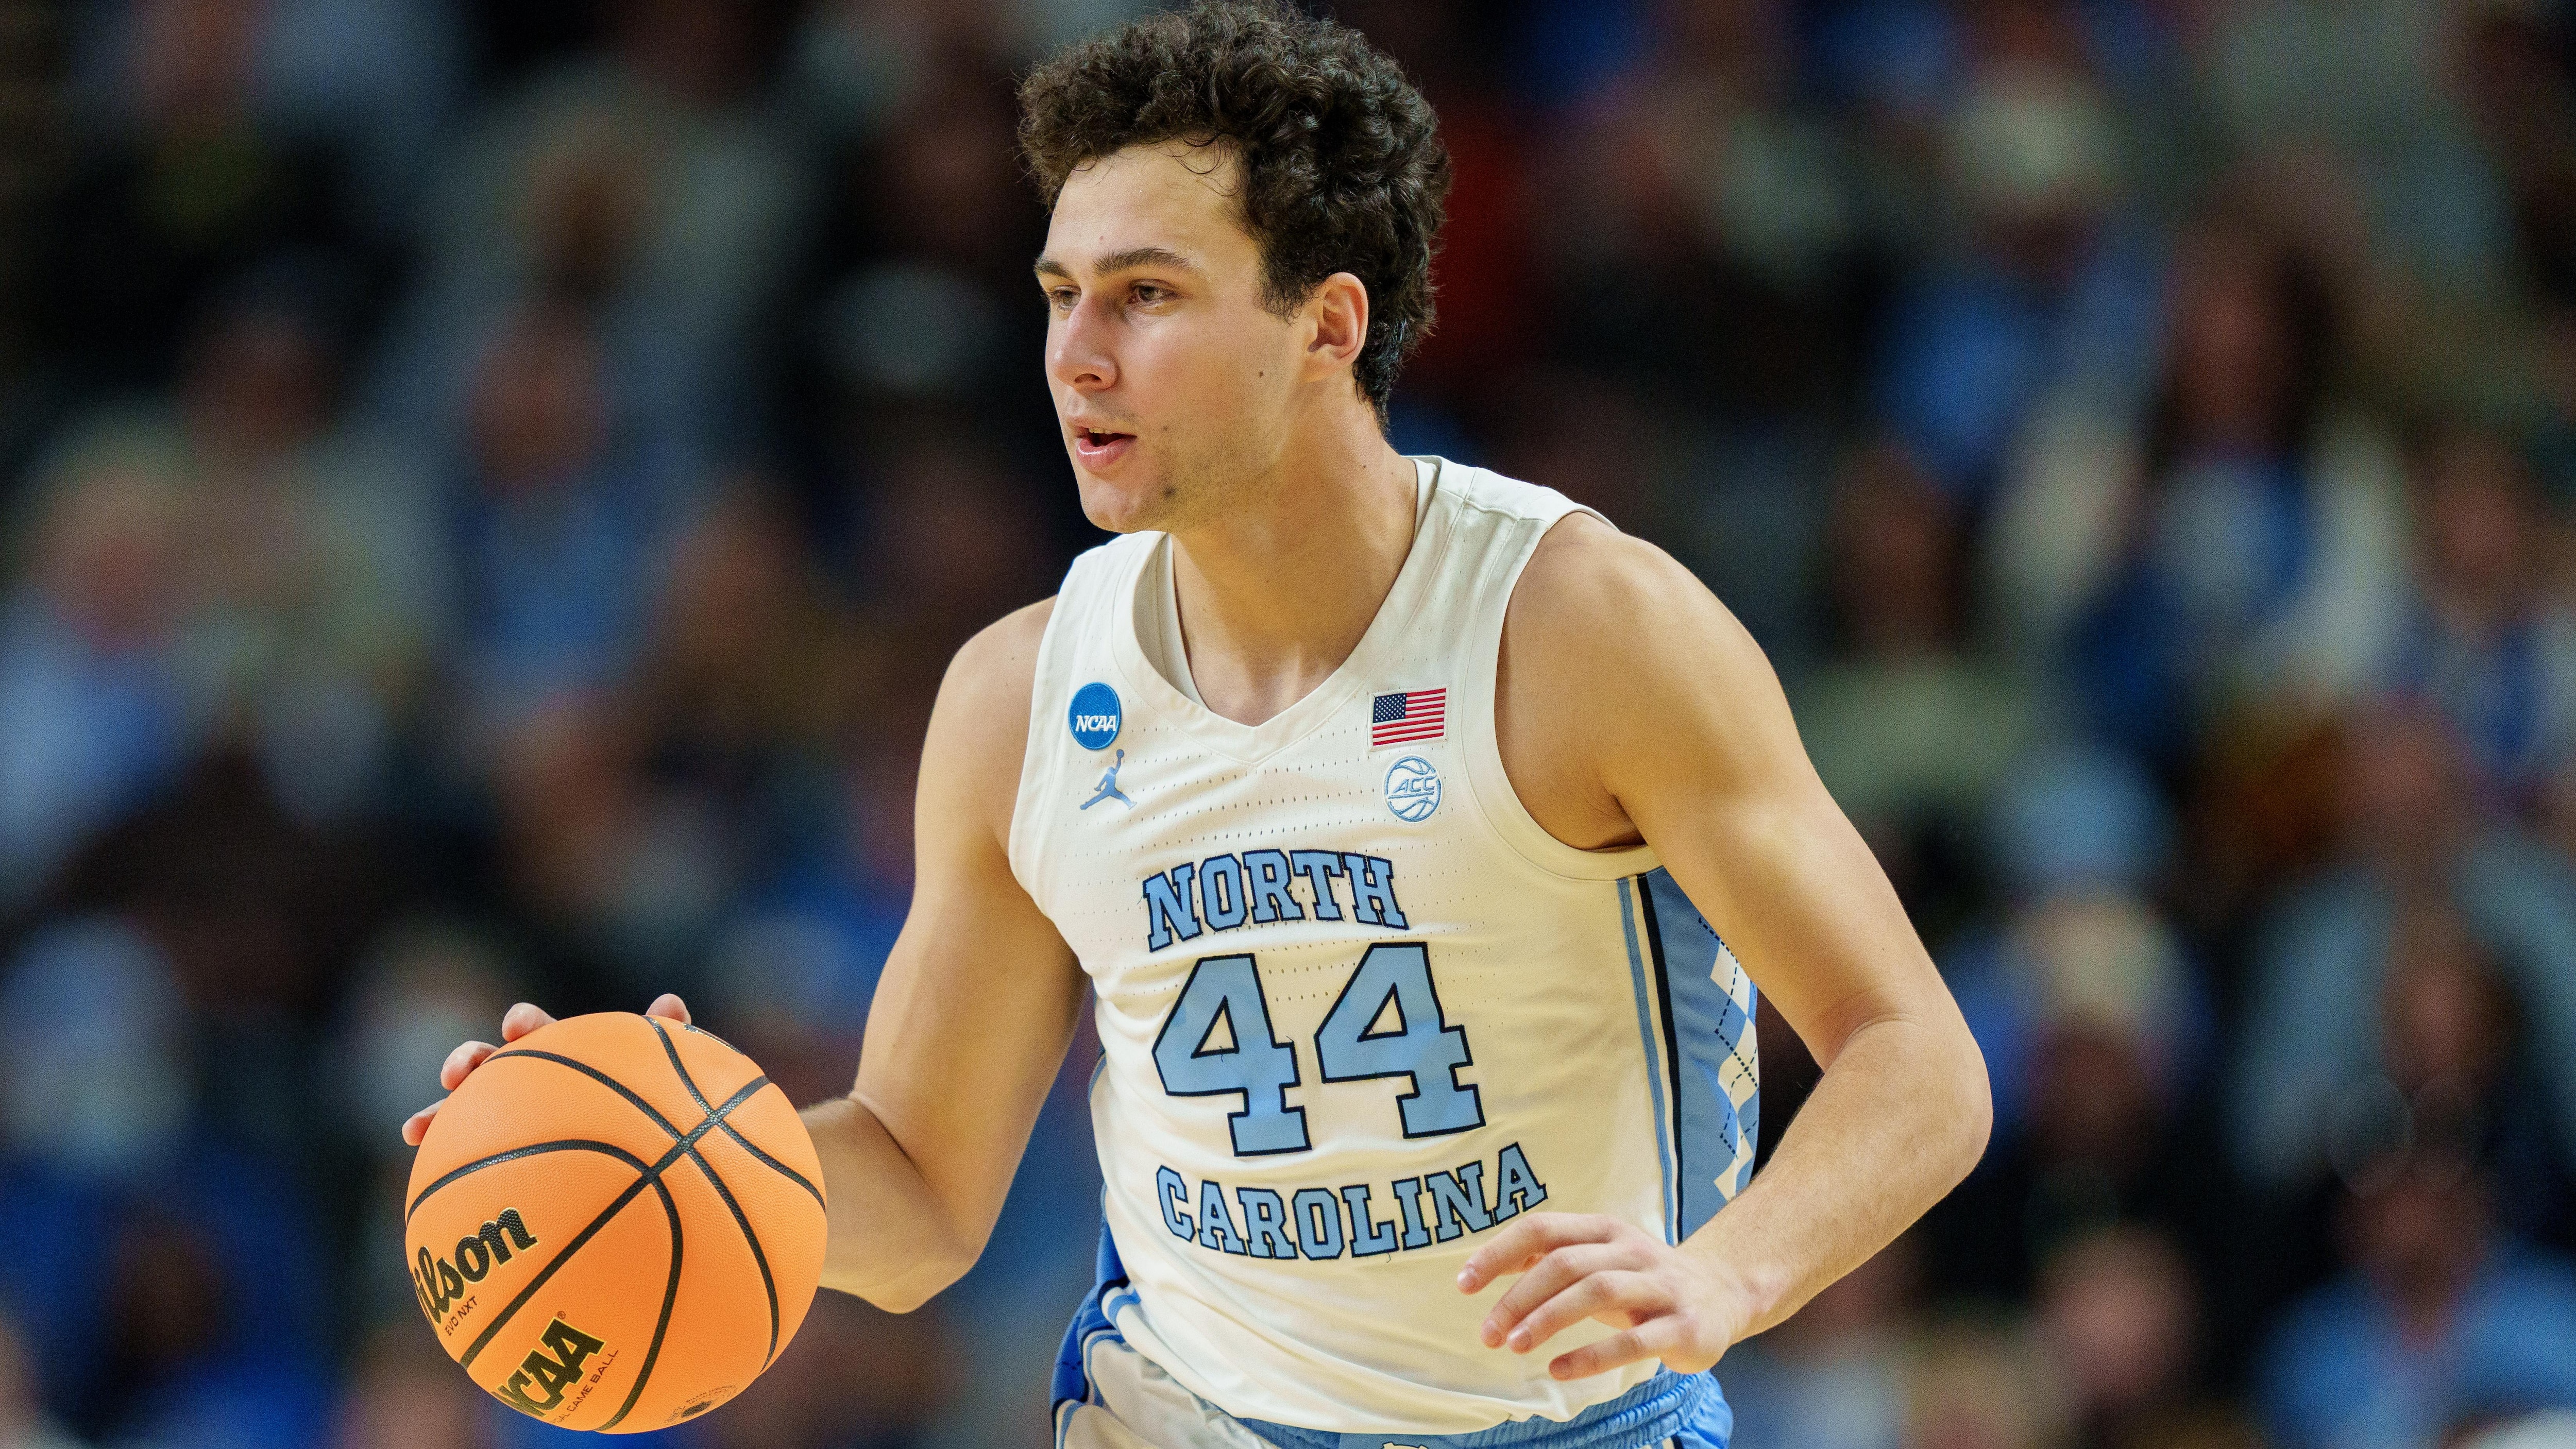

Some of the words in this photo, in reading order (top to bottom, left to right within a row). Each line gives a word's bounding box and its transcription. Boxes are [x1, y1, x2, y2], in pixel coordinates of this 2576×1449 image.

[1075, 715, 1116, 732] NCAA
[1393, 775, 1436, 793] ACC
[1143, 849, 1409, 952] NORTH
[1151, 942, 1486, 1156] 44
[1156, 1141, 1548, 1260] CAROLINA
[414, 1206, 539, 1325] ilson
[445, 1316, 458, 1336] EVO
[457, 1295, 477, 1319] NXT
[590, 1350, 618, 1384] BALL
